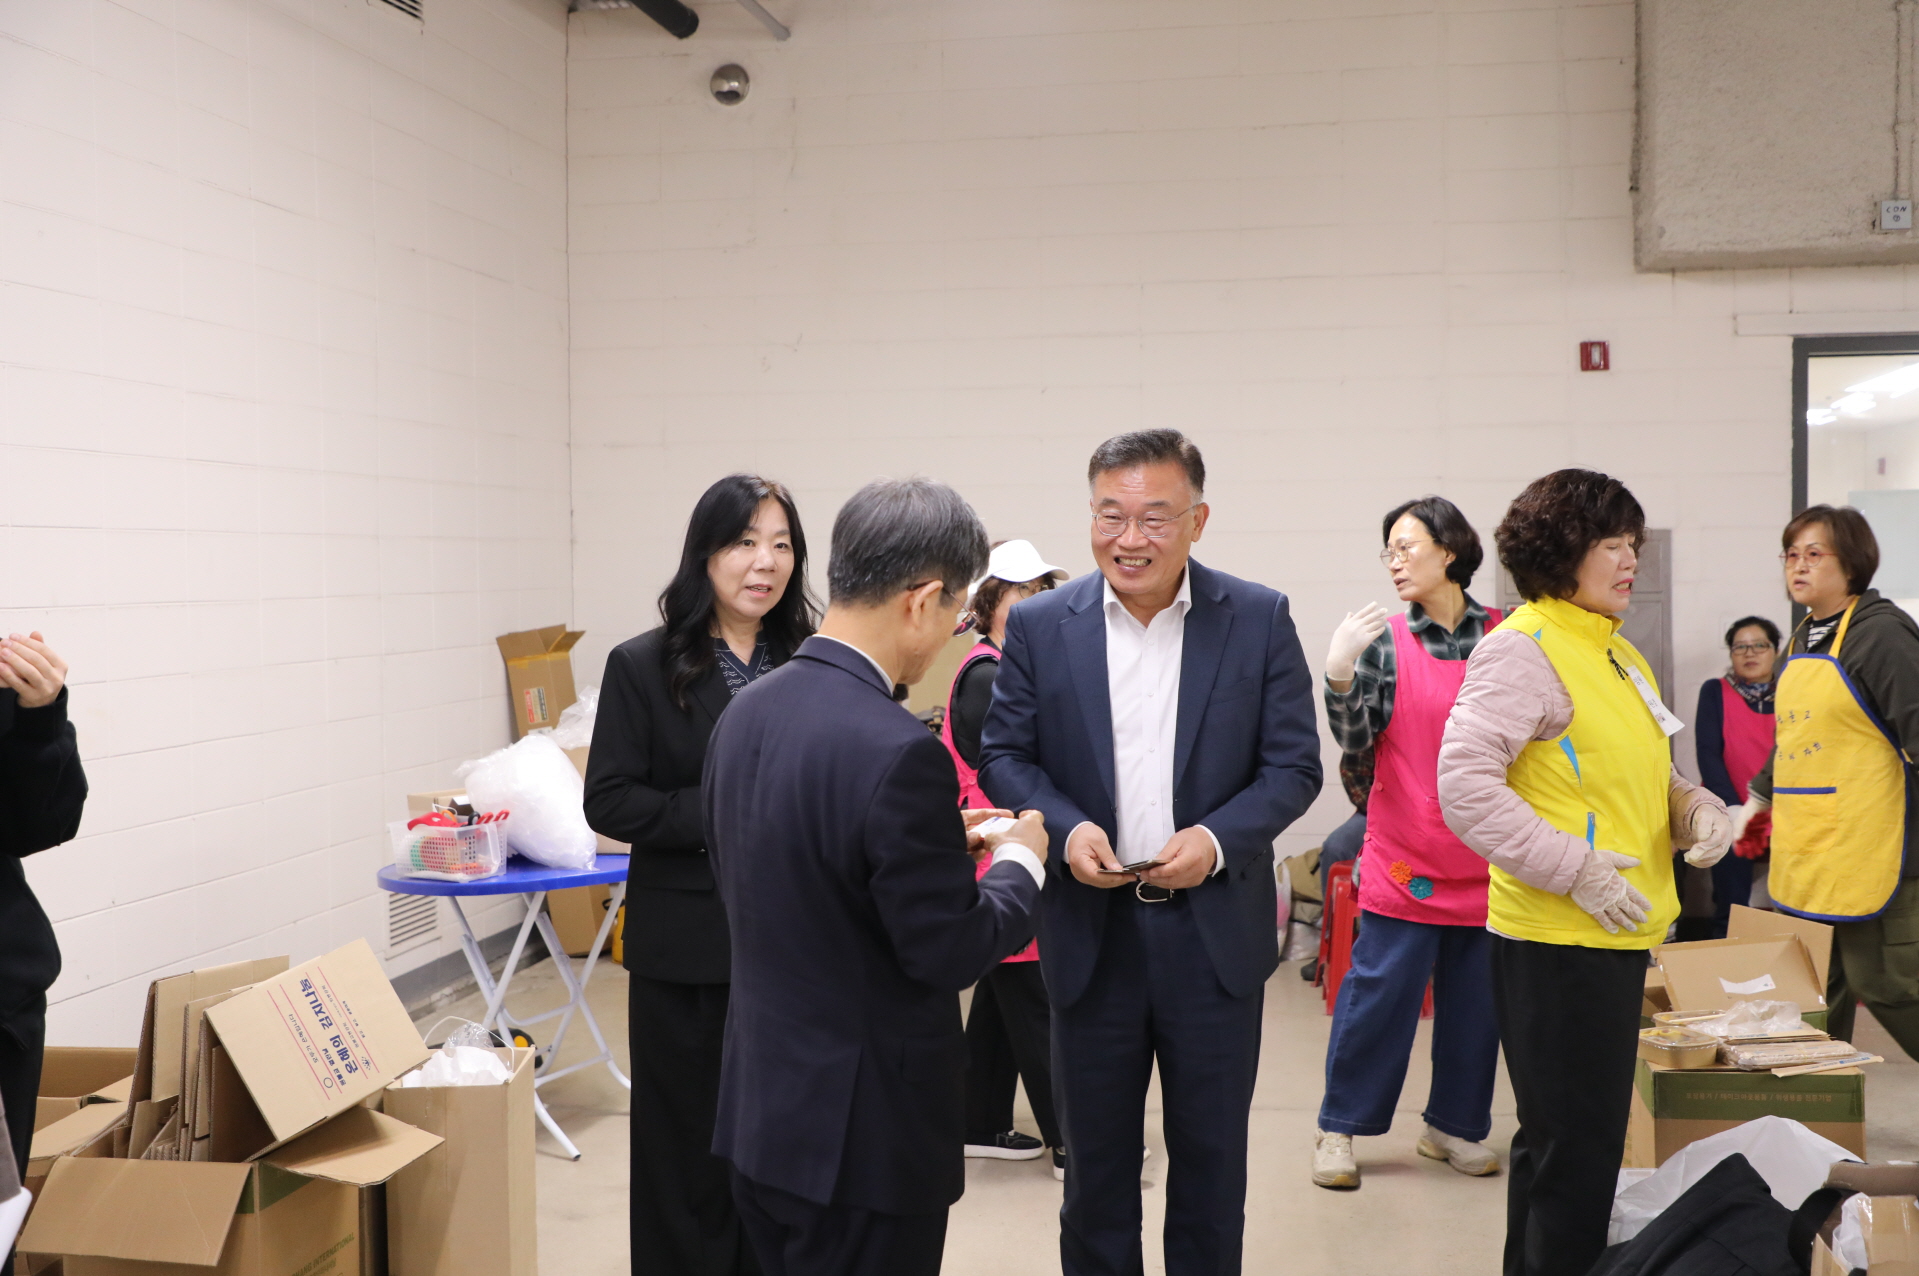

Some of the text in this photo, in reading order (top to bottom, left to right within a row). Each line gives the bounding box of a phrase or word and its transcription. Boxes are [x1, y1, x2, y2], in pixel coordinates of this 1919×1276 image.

[288, 1013, 319, 1063] 모두가 은혜입니다
[298, 977, 359, 1075] 은혜의 김치나눔
[313, 1232, 355, 1269] INTERNATIONAL
